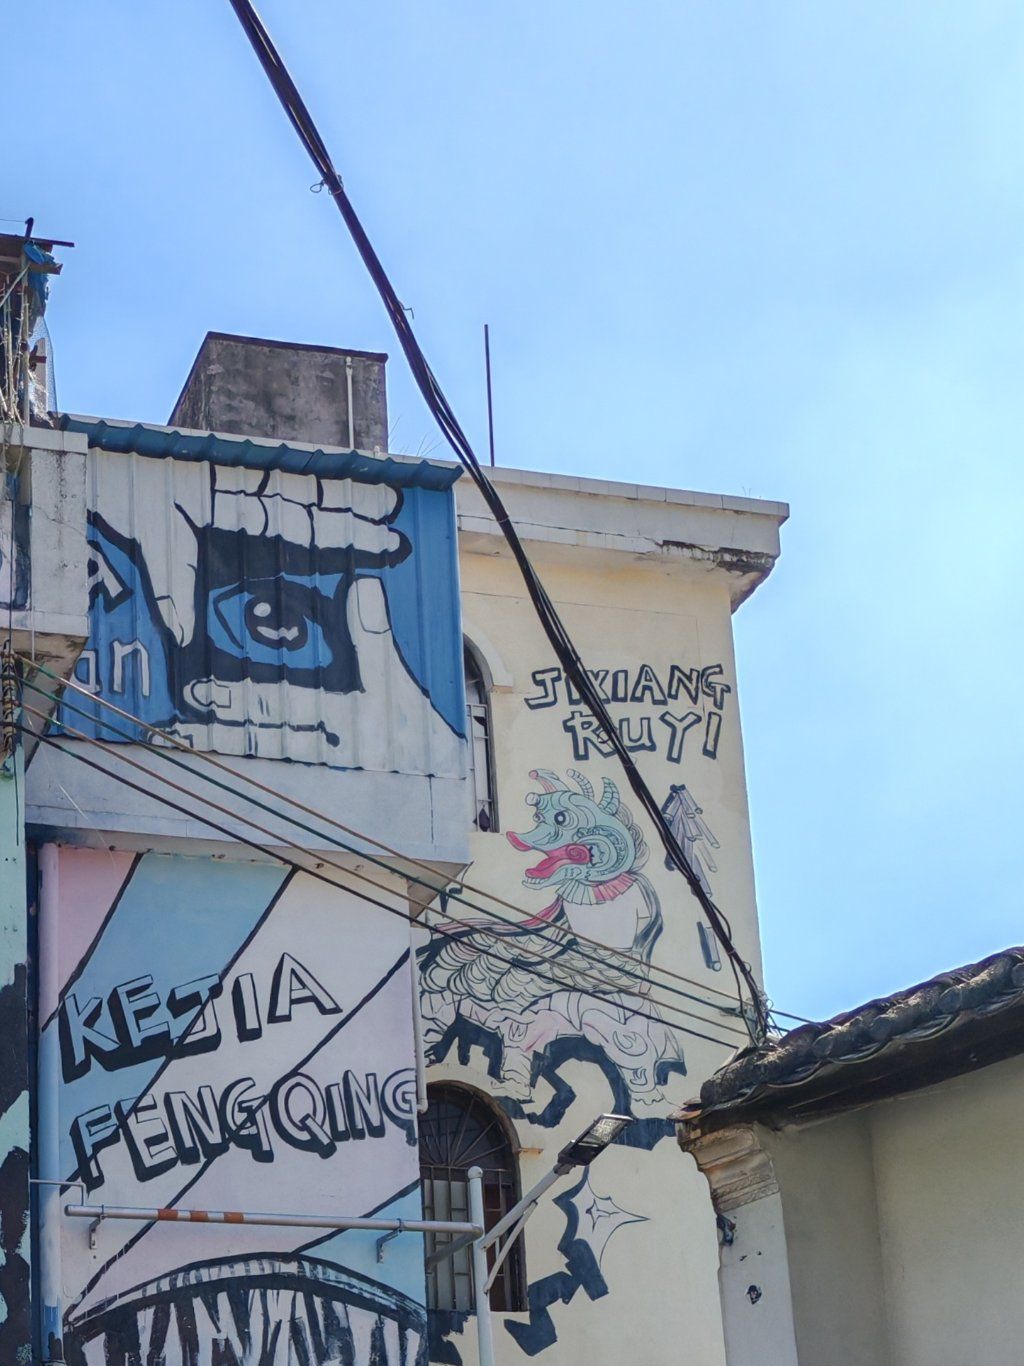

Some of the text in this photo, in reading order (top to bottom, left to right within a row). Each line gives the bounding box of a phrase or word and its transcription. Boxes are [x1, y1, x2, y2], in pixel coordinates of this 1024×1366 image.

[562, 711, 722, 763] RUYI
[58, 951, 343, 1083] KEJIA
[69, 1066, 417, 1197] FENGQING
